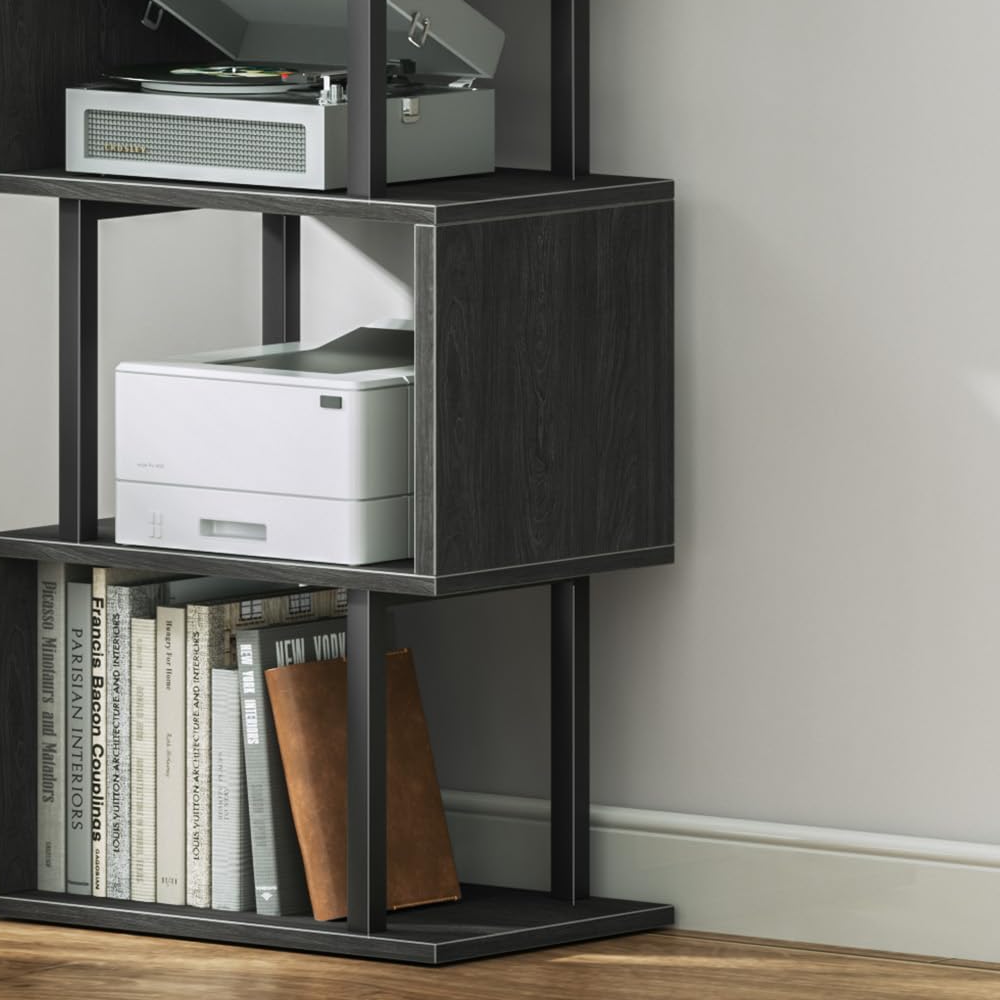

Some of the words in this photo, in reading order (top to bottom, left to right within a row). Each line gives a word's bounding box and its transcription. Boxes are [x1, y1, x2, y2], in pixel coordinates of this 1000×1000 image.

[42, 581, 57, 630] Picasso
[92, 597, 104, 668] Francis
[112, 613, 120, 667] INTERIORS
[164, 620, 173, 649] Hungry
[240, 644, 253, 665] NEW
[42, 636, 57, 704] Minotaurs
[71, 628, 83, 720] PARISIAN
[165, 652, 173, 667] For
[165, 668, 173, 690] Home
[192, 631, 200, 682] INTERIORS
[112, 670, 120, 695] AND
[192, 684, 200, 709] AND
[242, 671, 255, 693] YORK
[42, 711, 57, 737] and
[92, 676, 104, 737] Bacon
[245, 699, 259, 744] INTERIORS
[112, 695, 120, 771] ARCHITECTURE
[192, 709, 200, 782] ARCHITECTURE
[42, 743, 57, 803] Matadors
[71, 729, 83, 831] INTERIORS
[112, 775, 120, 821] VUITTON
[192, 785, 200, 829] VUITTON
[112, 824, 120, 852] LOUIS
[192, 833, 200, 860] LOUIS
